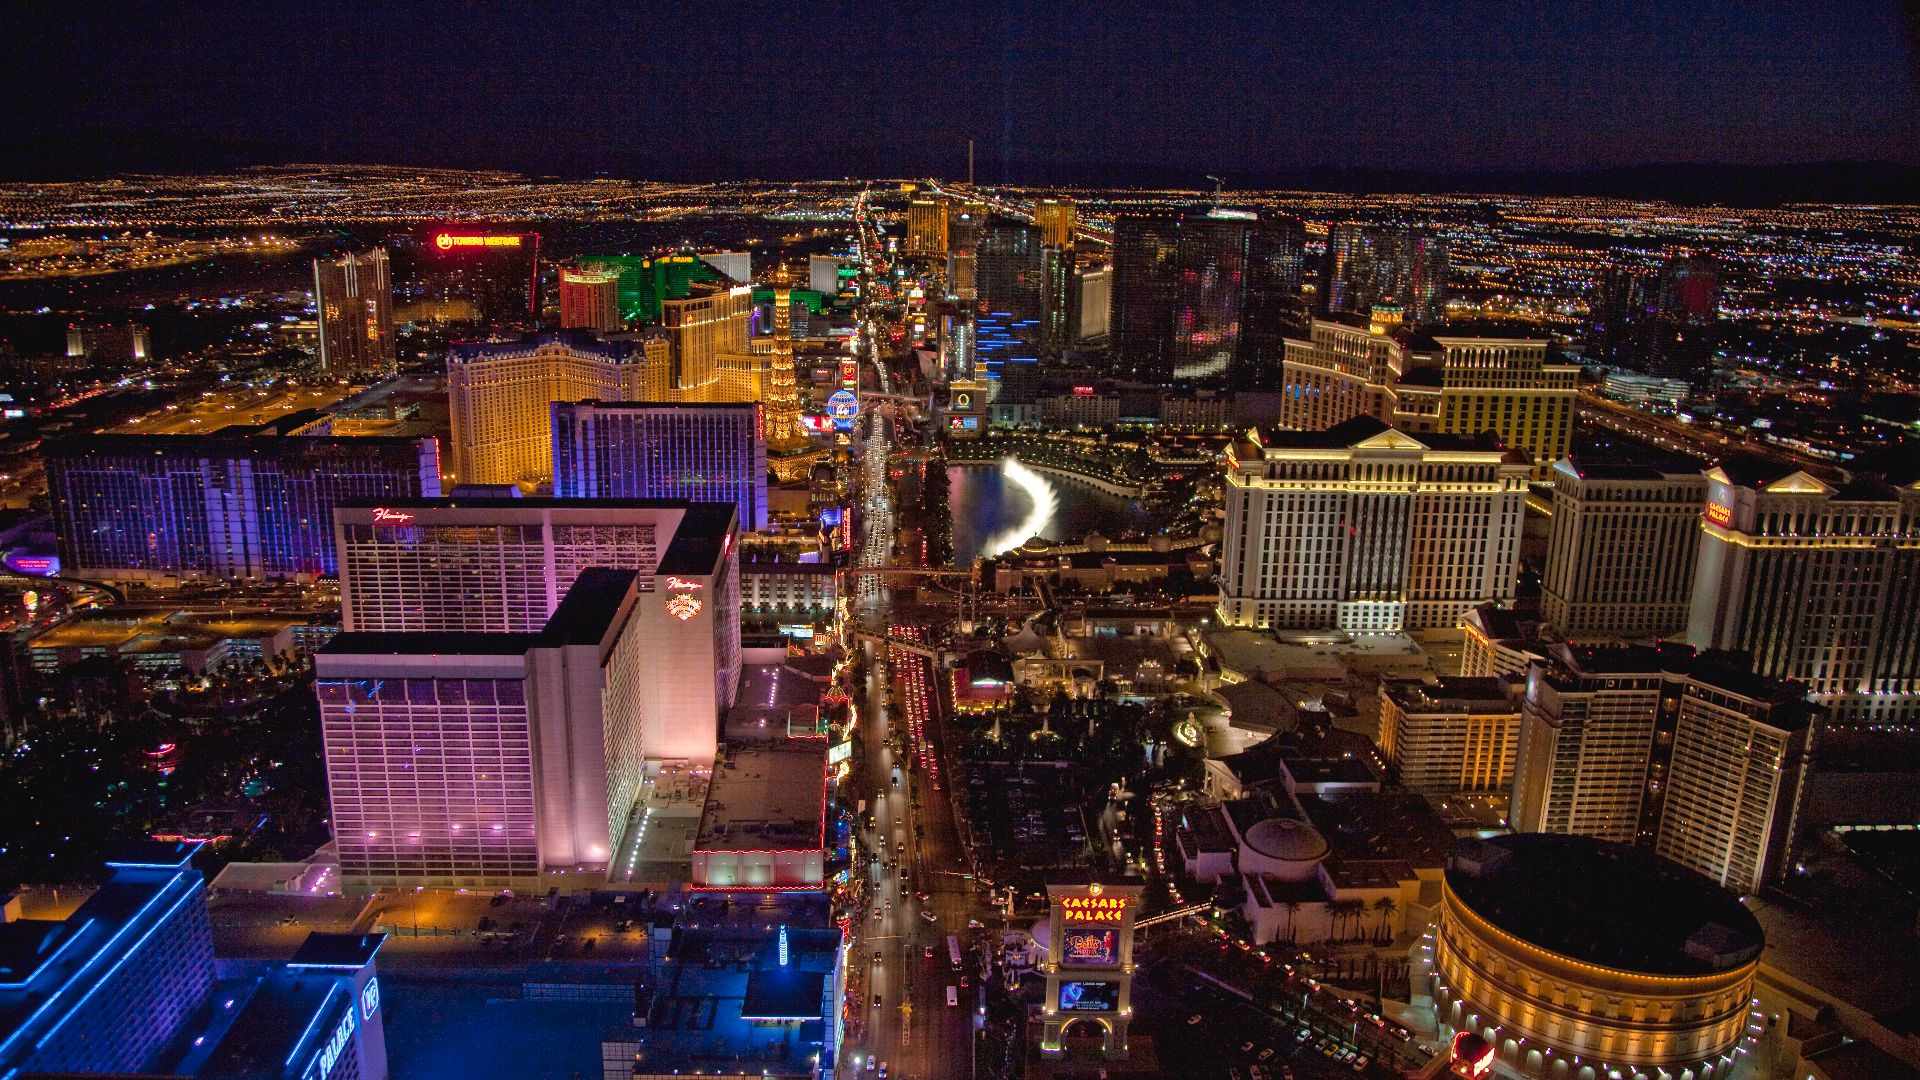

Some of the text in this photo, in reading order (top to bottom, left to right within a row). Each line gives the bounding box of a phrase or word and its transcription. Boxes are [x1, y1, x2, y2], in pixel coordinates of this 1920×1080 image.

[453, 236, 484, 246] TOWERS
[372, 507, 414, 523] Flamingo
[1062, 897, 1127, 909] CAESARS
[1065, 909, 1122, 921] PALACE
[319, 1006, 355, 1080] PALACE
